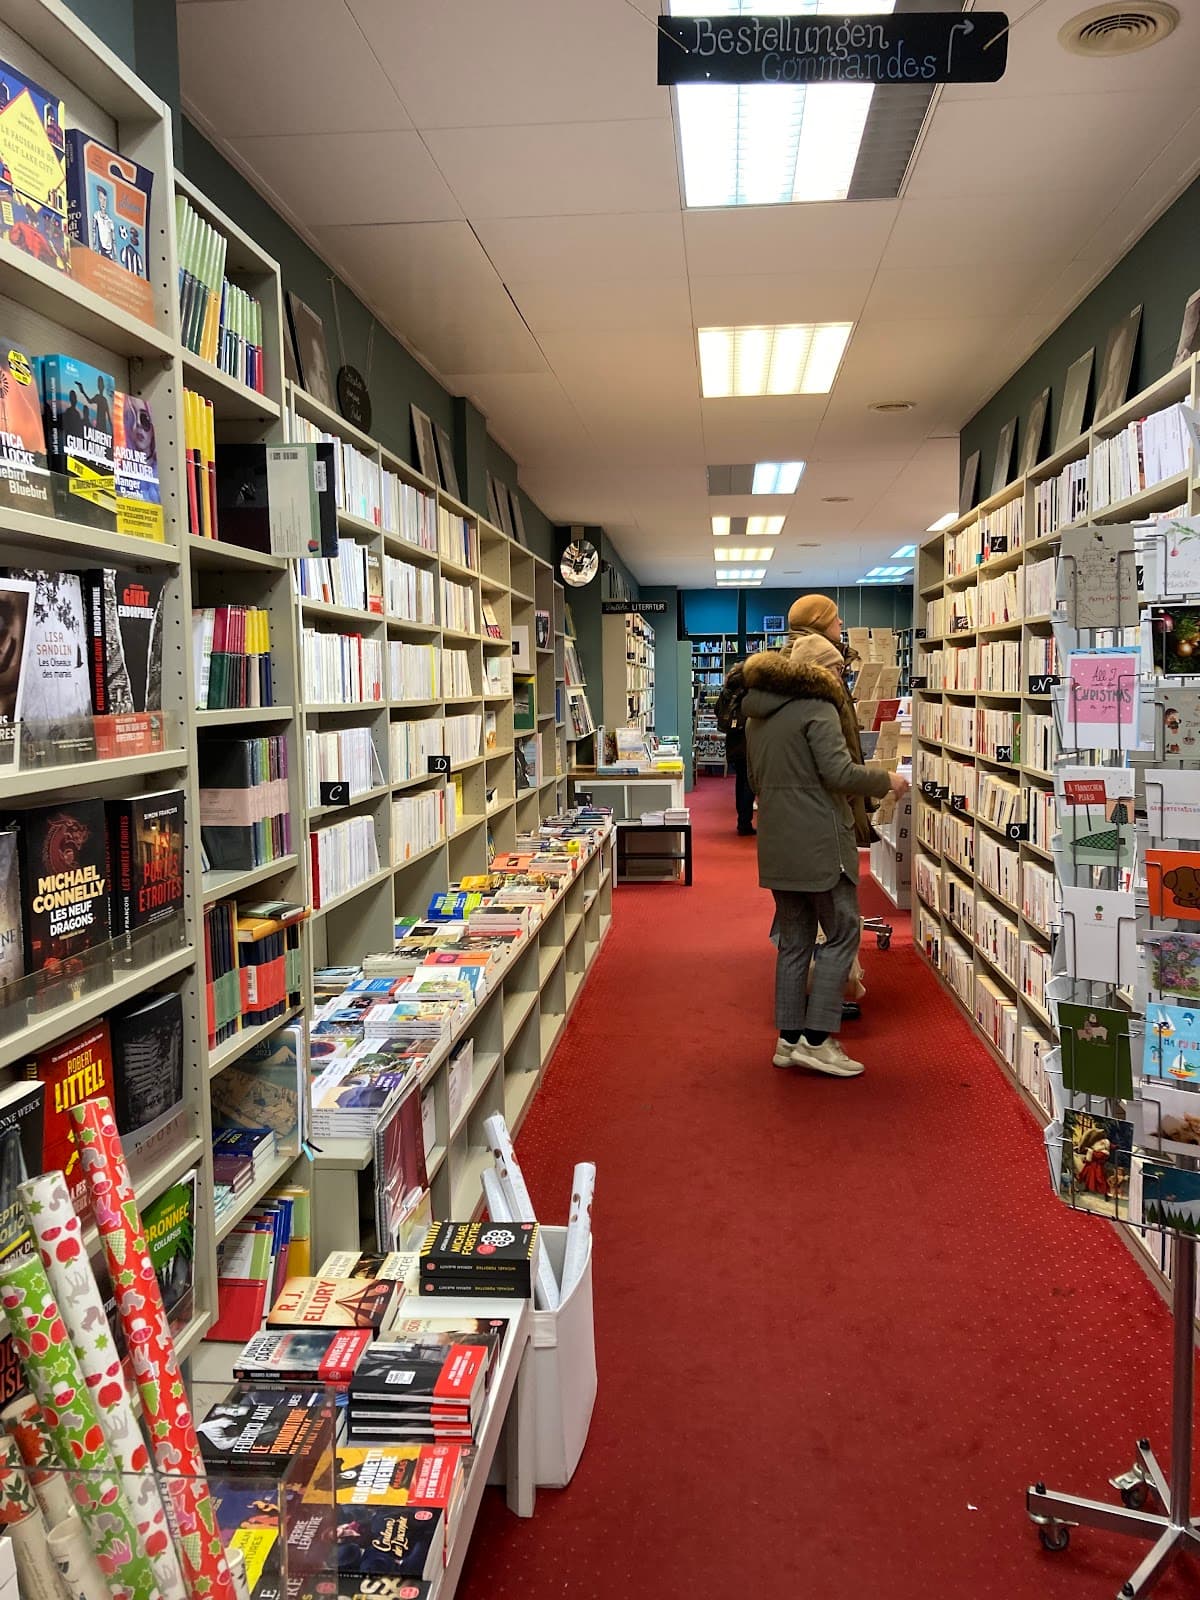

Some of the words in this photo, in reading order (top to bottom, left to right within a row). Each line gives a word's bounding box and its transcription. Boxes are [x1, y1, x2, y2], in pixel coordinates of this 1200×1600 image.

[692, 17, 889, 59] Bestellungen
[761, 40, 936, 82] Commandes
[66, 433, 108, 460] GUILLAUME
[83, 425, 113, 450] LAURENT
[3, 446, 35, 467] LOCKE
[9, 479, 48, 502] Bluebird
[631, 602, 665, 612] LITERATUR
[44, 631, 64, 643] LISA
[36, 643, 73, 657] SANDLIN
[39, 659, 49, 668] Les
[1092, 665, 1107, 682] All
[1031, 677, 1054, 692] N
[1075, 688, 1132, 704] CHRISTMAS
[434, 757, 447, 770] D
[328, 785, 343, 800] C
[1078, 791, 1096, 802] PLEASE
[38, 865, 101, 895] MICHAEL
[32, 879, 106, 914] CONNELLY
[50, 905, 68, 923] LES
[68, 900, 93, 918] NEUF
[50, 913, 94, 937] DRAGONS
[67, 1048, 93, 1075] ROBERT
[54, 1059, 106, 1114] LITTELL
[143, 1201, 190, 1243] BRONNEC
[450, 1223, 470, 1253] MICHAEL
[462, 1221, 483, 1256] FORSYTHE
[303, 1280, 337, 1322] ELLORY
[254, 1335, 284, 1362] CARRISI
[270, 1408, 309, 1455] PROMONTOIRE
[250, 1445, 271, 1455] LE
[351, 1449, 382, 1503] GIACOMETTI
[372, 1456, 398, 1495] RAVENNE
[287, 1520, 309, 1545] PIERRE
[296, 1515, 323, 1550] LEMAITRE
